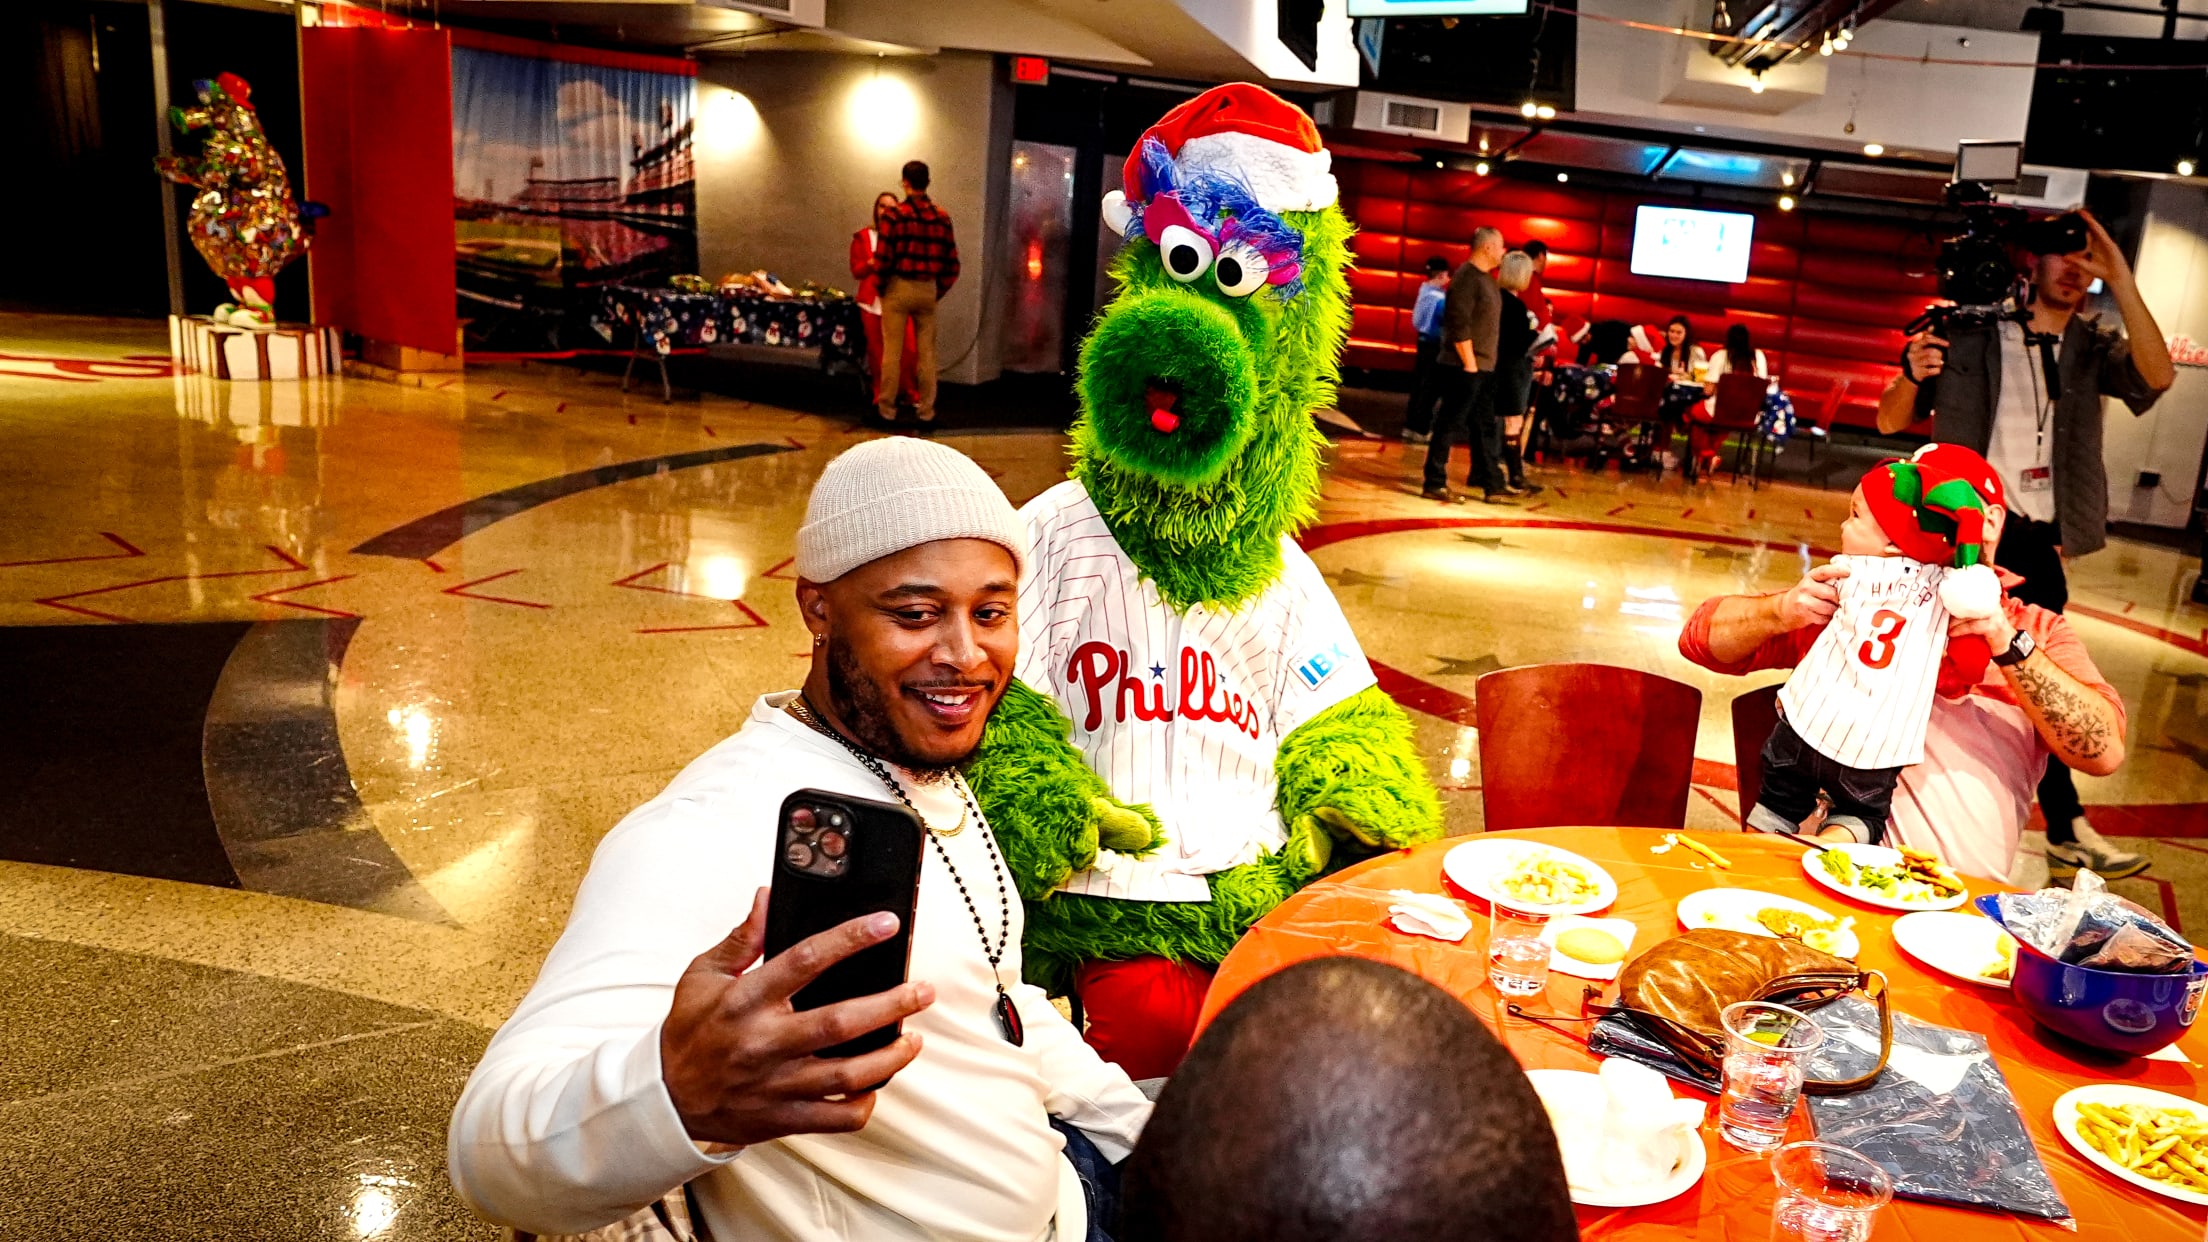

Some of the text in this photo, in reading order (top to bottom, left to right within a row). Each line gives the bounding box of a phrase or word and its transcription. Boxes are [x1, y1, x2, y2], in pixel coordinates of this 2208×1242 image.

[1299, 643, 1350, 685] IBX
[1858, 609, 1906, 669] 3
[1066, 641, 1260, 740] Phillies
